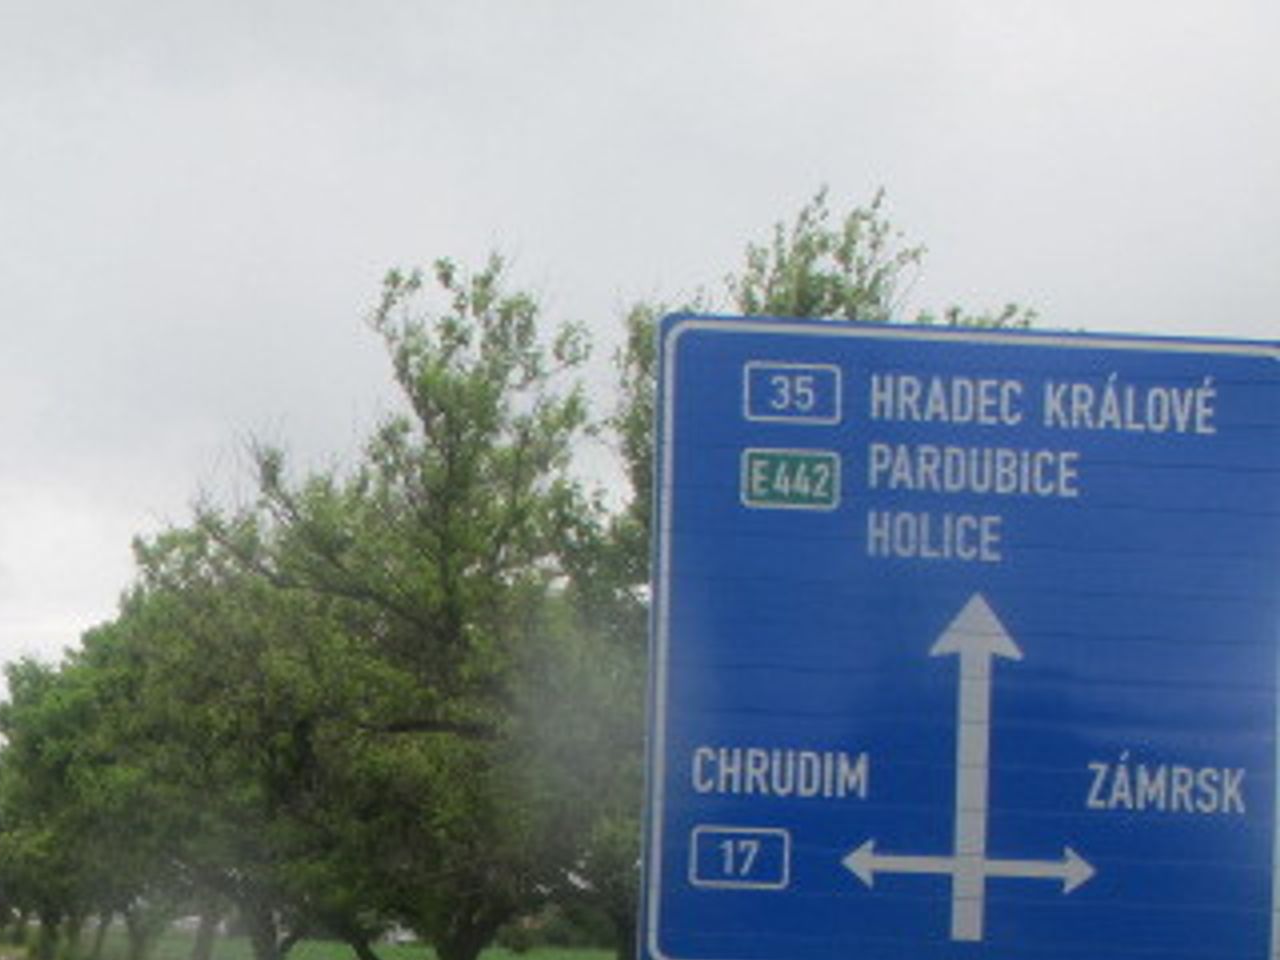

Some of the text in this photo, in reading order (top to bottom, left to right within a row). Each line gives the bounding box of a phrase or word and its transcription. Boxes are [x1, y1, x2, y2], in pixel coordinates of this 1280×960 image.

[770, 376, 816, 411] 35
[870, 373, 1217, 434] HRADEC KRÁLOVÉ
[750, 458, 831, 498] E442
[868, 443, 1079, 497] PARDUBICE
[867, 511, 1002, 561] HOLICE
[691, 746, 869, 798] CHRUDIM
[1086, 751, 1246, 813] ZÁMRSK
[719, 840, 759, 877] 17
